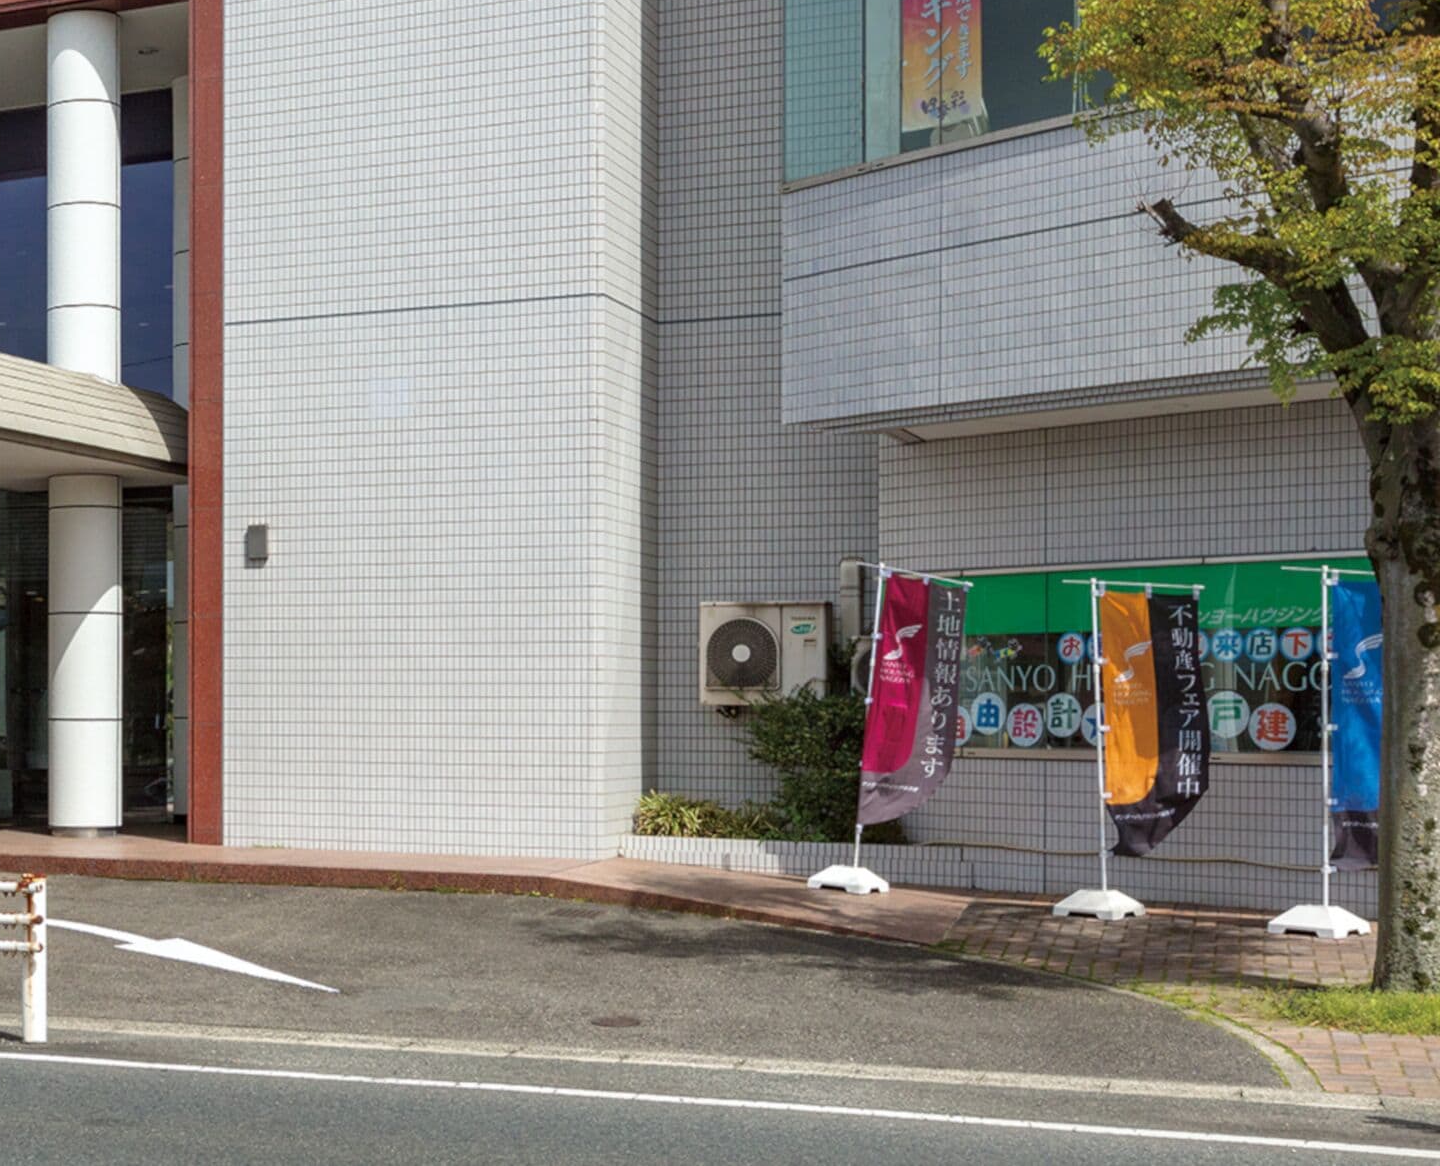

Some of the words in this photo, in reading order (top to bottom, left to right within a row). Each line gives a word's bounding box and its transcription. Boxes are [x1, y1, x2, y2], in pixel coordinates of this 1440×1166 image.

[920, 591, 961, 779] 土地情報あります
[966, 663, 1057, 693] SANYO
[1233, 661, 1333, 692] NAGO
[1167, 603, 1202, 800] 不動産フェア開催中
[1211, 697, 1291, 743] 戸建
